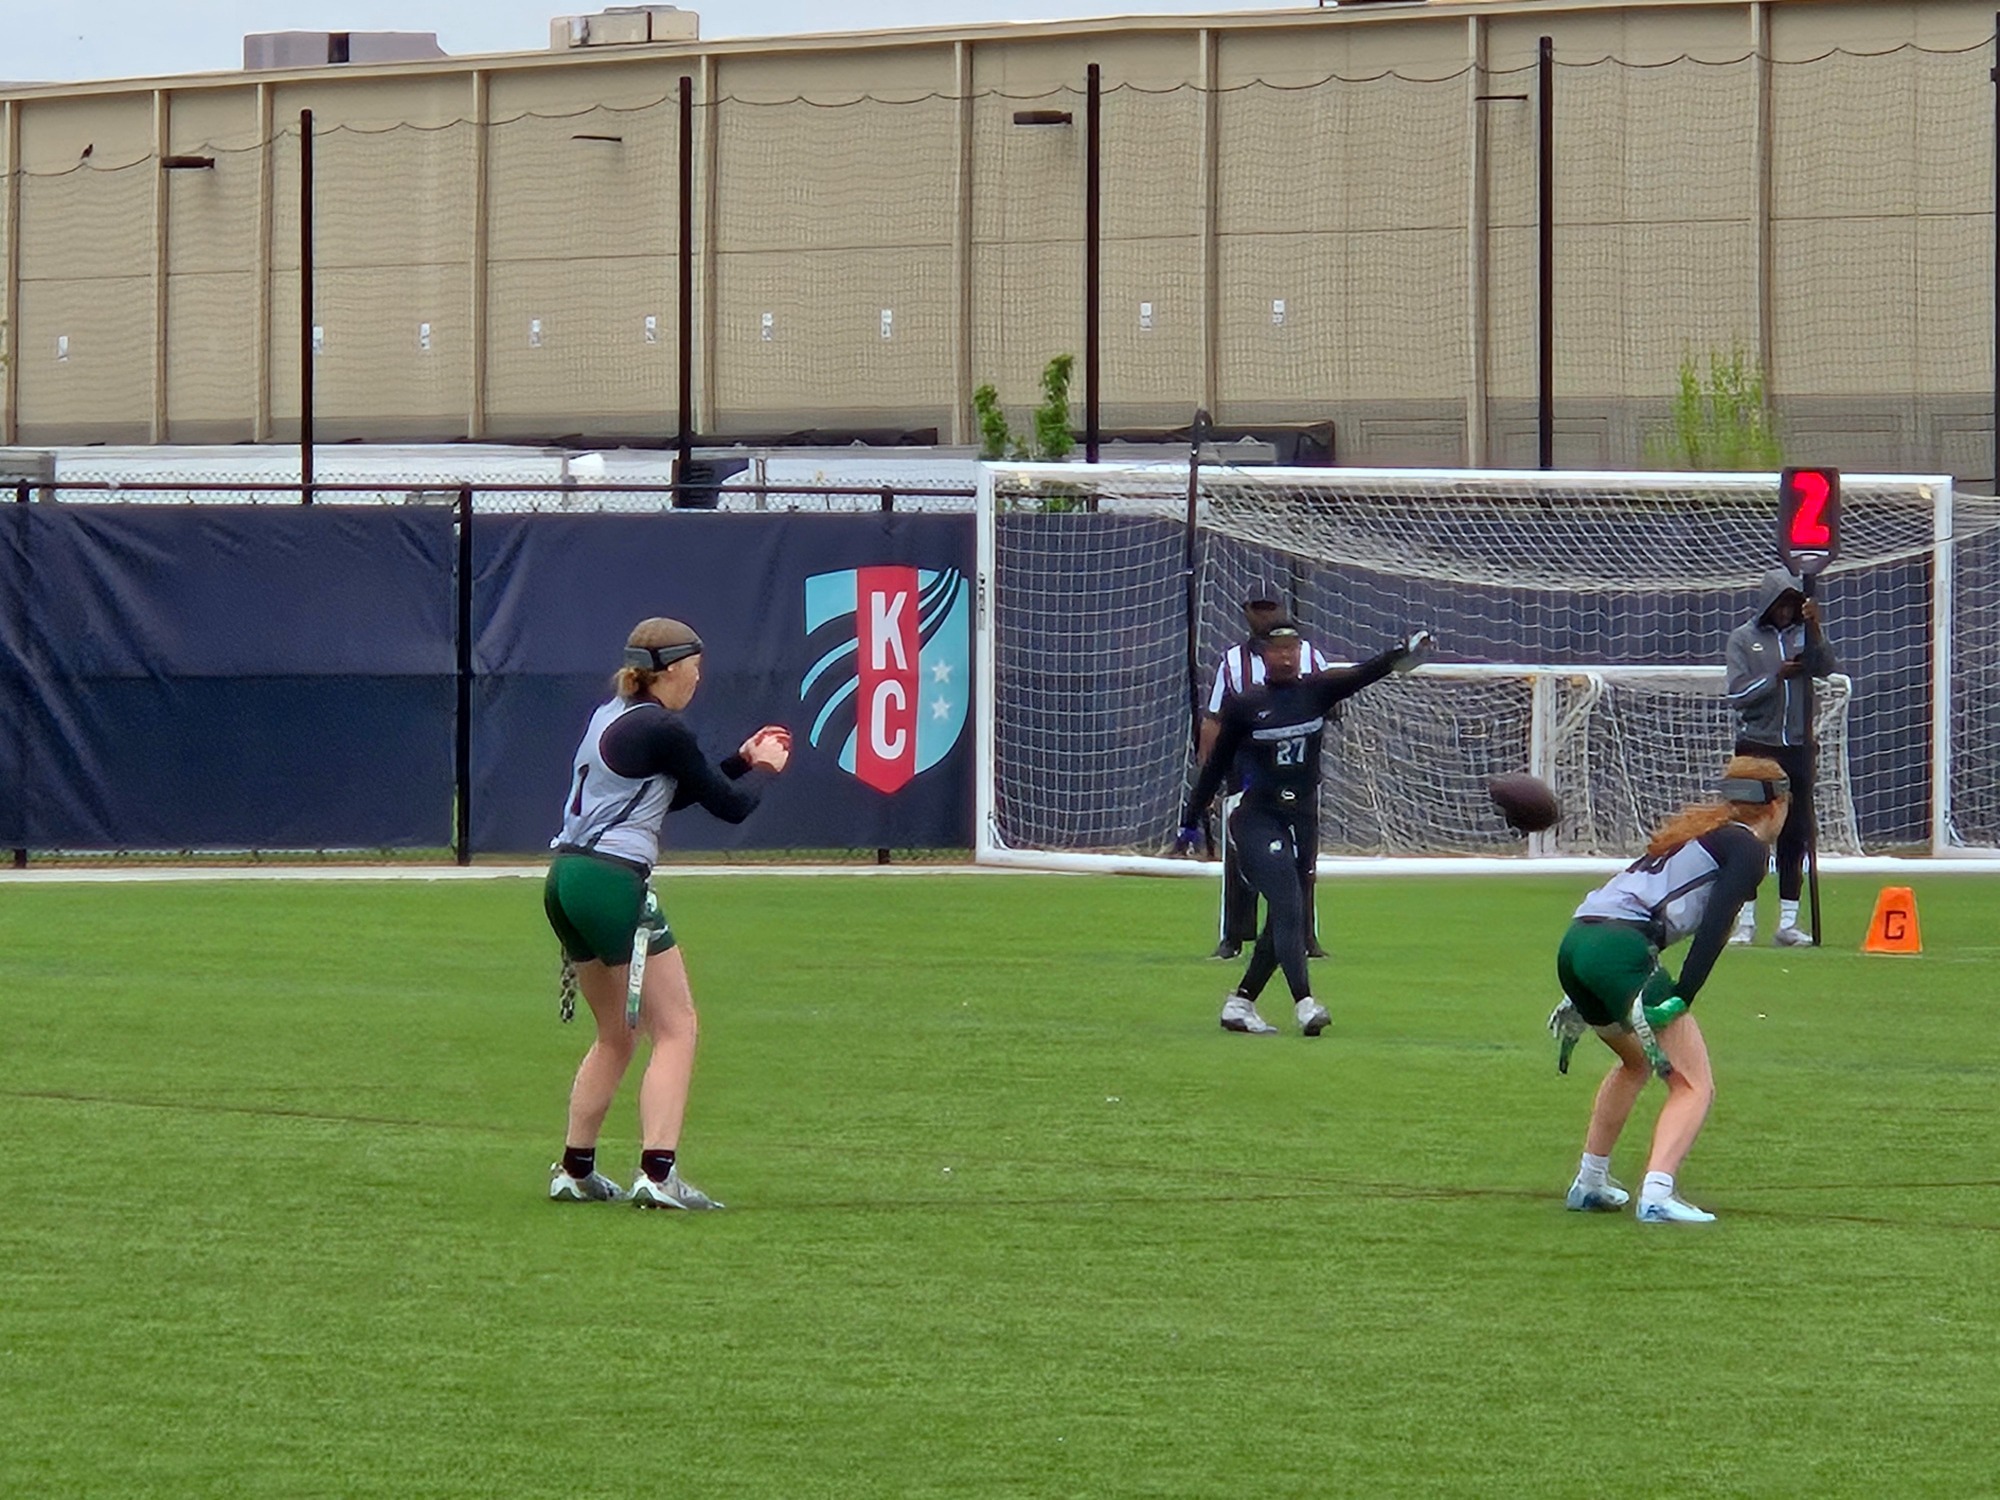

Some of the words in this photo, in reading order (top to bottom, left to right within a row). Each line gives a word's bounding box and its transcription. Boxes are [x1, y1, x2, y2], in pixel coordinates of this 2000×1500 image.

[1792, 472, 1830, 544] 2
[871, 591, 908, 760] KC
[1276, 737, 1306, 765] 27
[1884, 910, 1907, 940] G
